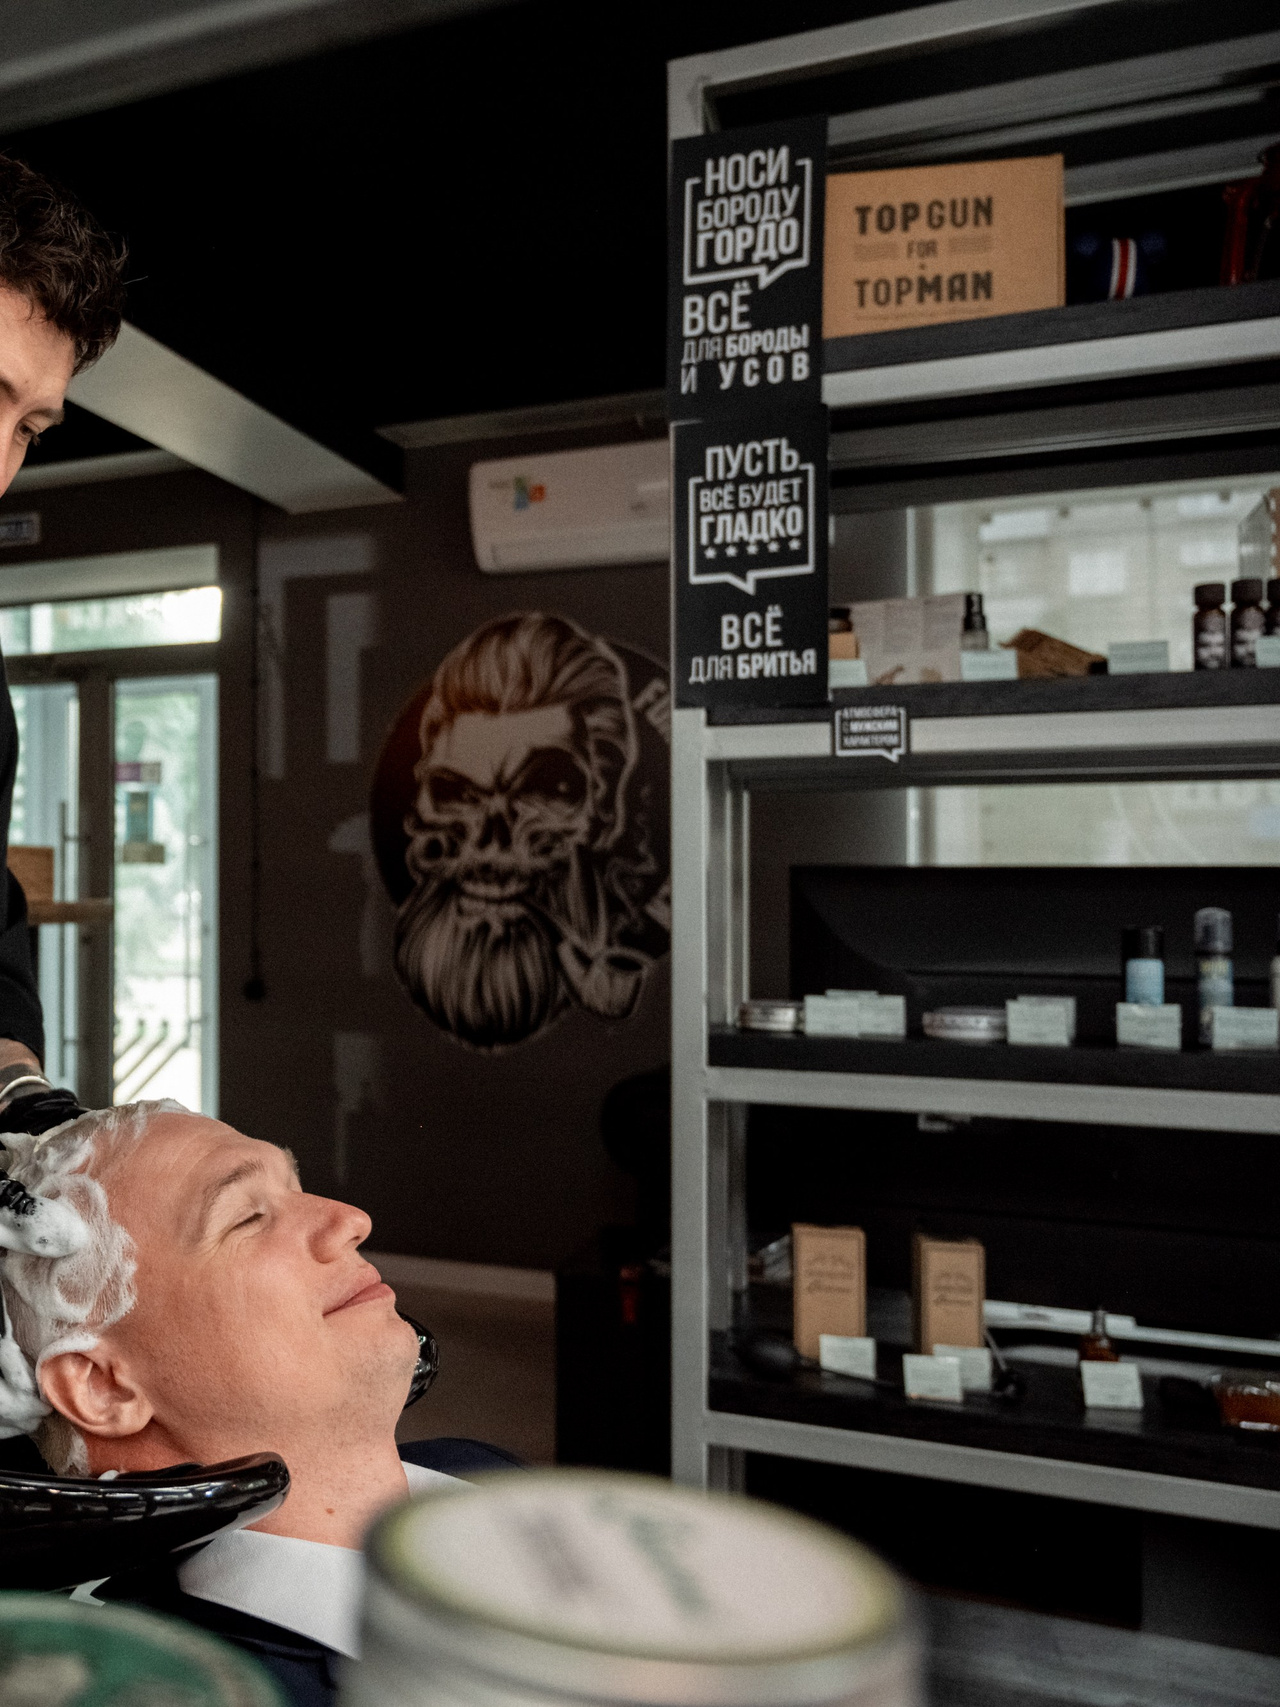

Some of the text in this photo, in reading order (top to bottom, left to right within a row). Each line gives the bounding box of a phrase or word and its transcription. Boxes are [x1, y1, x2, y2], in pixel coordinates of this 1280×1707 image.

[705, 146, 789, 197] НОСИ
[697, 184, 800, 231] БОРОДУ
[696, 217, 800, 268] ГОРДО
[683, 280, 752, 337] ВСЁ
[854, 271, 993, 308] TOPMAN
[681, 323, 810, 366] ДЛЯ БОРОДЫ
[681, 351, 810, 395] И УСОВ
[705, 437, 799, 481] ПУСТЬ
[699, 477, 803, 512] ВСЁ БУДЕТ
[700, 505, 804, 546] ГЛАДКО
[721, 604, 784, 650] ВСЁ
[689, 654, 734, 684] ДЛЯ
[737, 648, 817, 679] БРИТЬЯ
